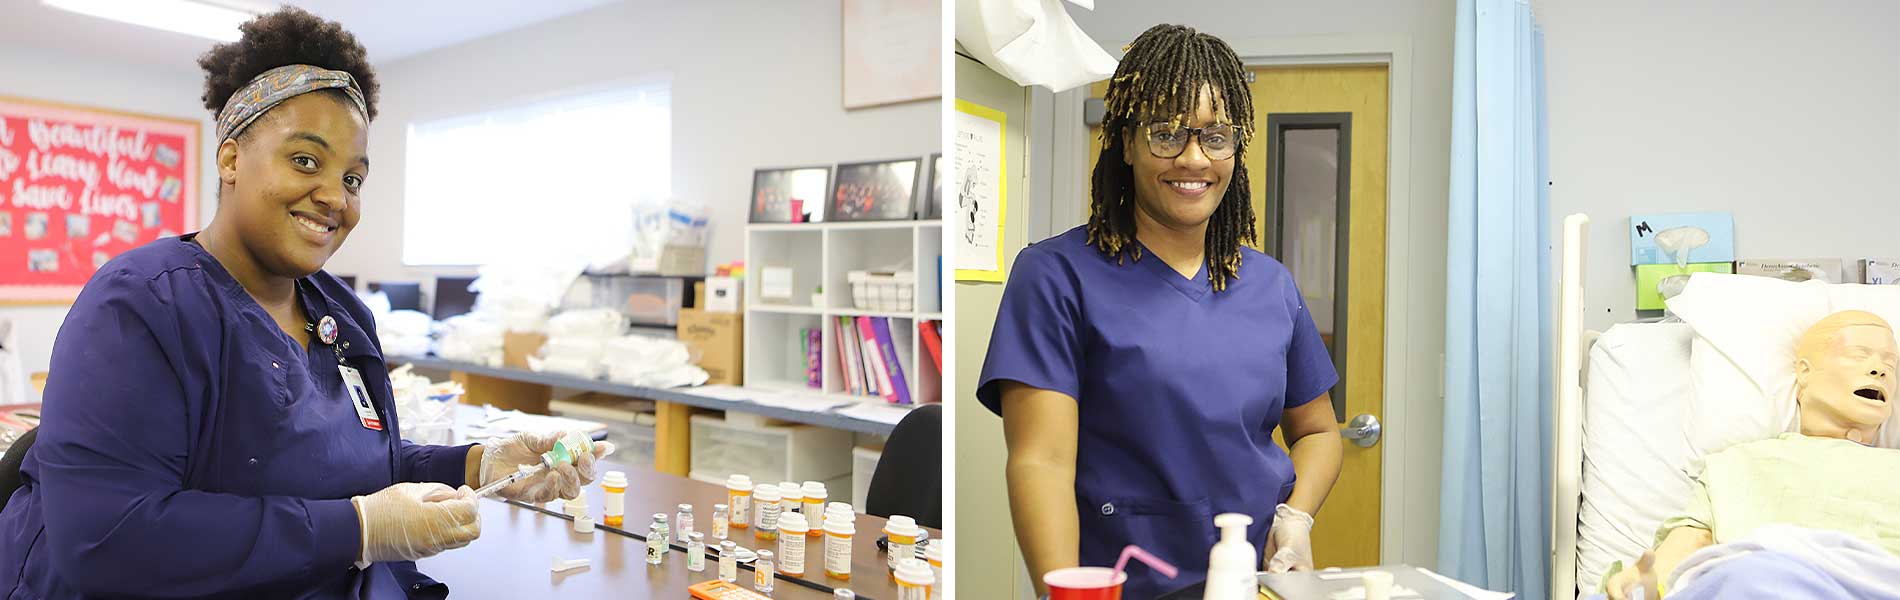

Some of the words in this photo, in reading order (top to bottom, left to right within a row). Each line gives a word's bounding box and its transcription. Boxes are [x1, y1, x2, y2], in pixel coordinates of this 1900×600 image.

[28, 118, 153, 161] Beautiful
[12, 176, 74, 210] Save
[80, 184, 138, 221] Lives
[1636, 221, 1653, 238] M
